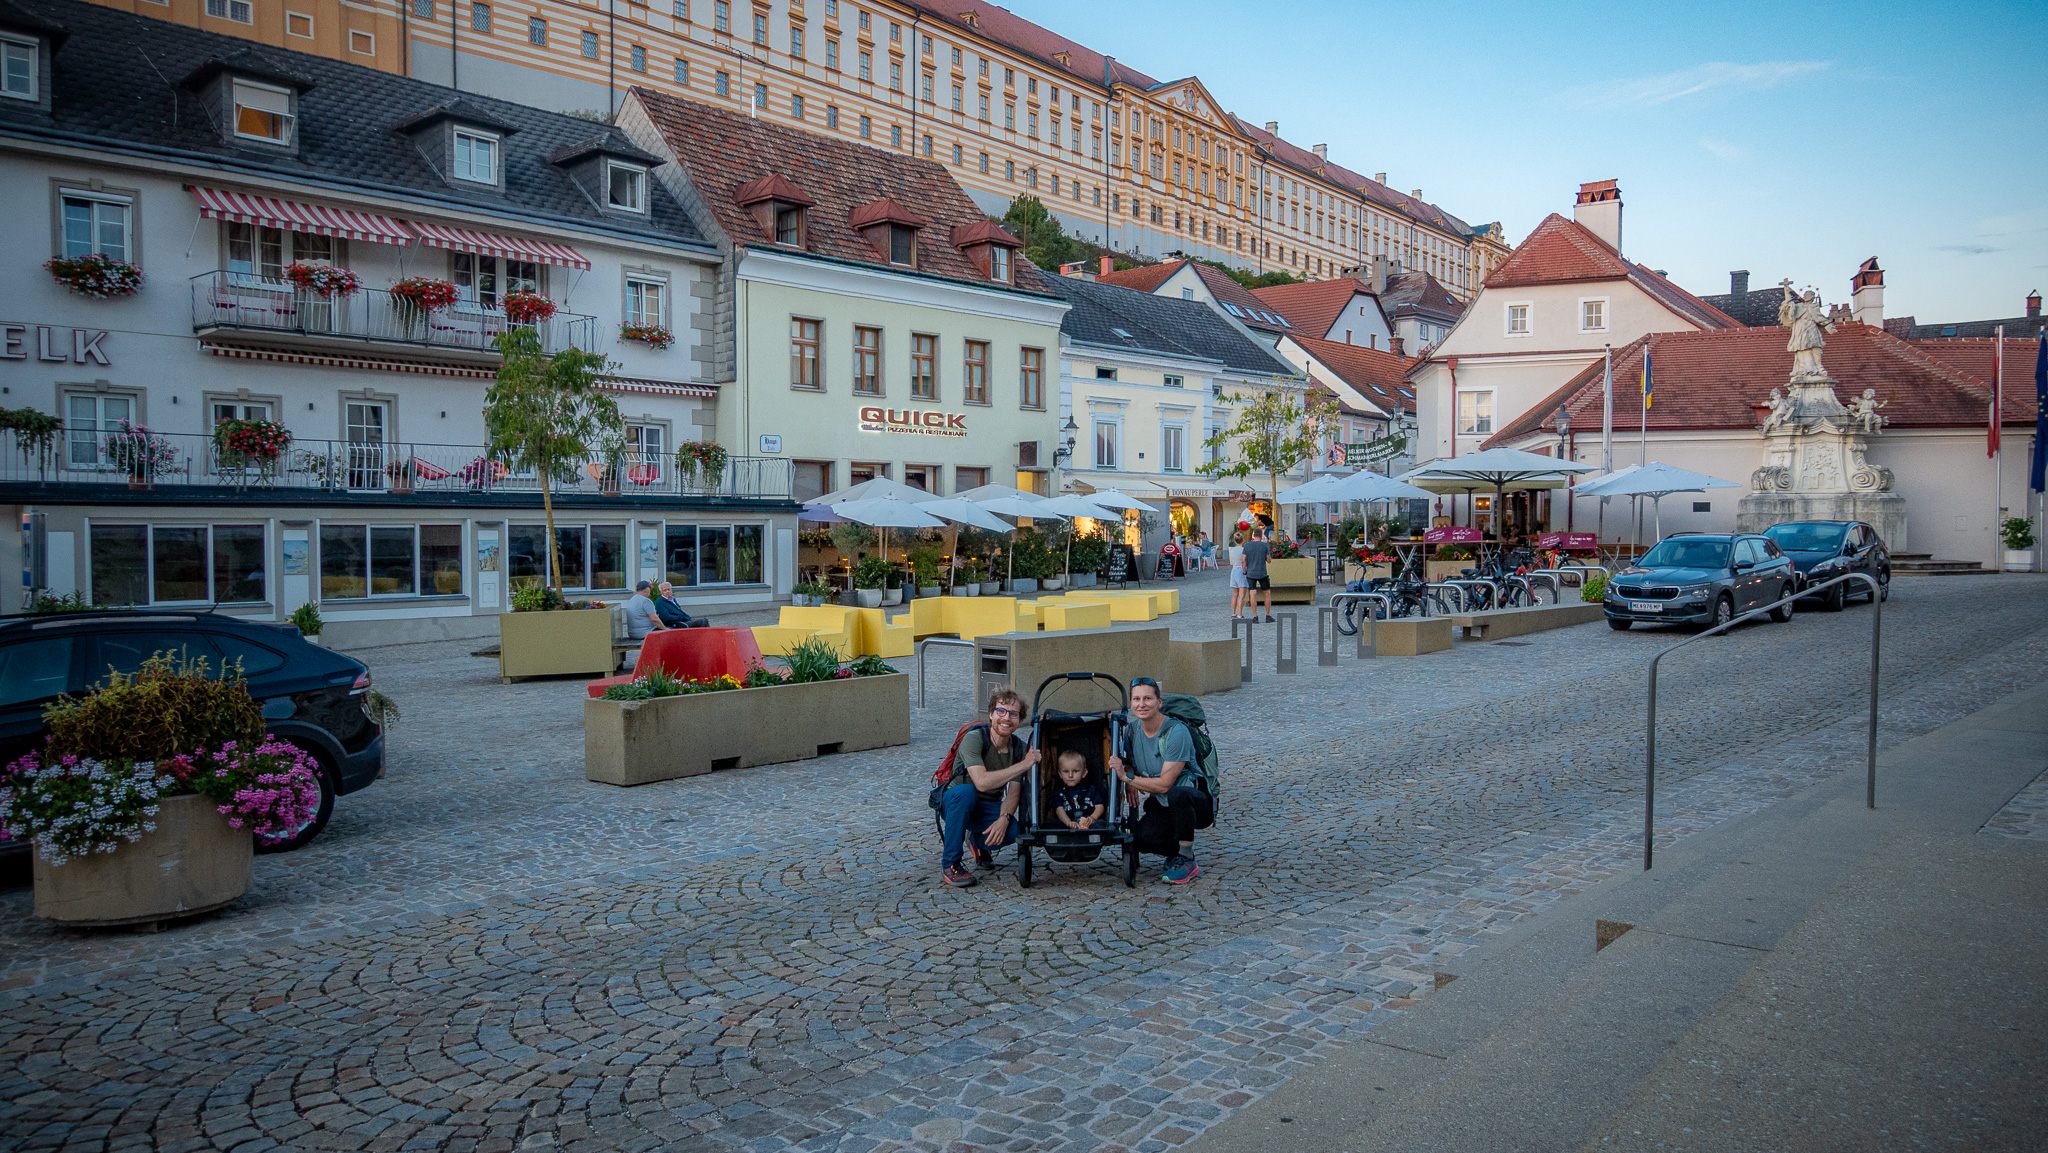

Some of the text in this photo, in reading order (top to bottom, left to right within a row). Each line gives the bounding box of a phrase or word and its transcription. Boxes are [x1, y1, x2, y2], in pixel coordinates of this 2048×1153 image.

[0, 323, 112, 366] ELK
[861, 407, 968, 429] QUICK
[925, 429, 968, 437] RESTAURANT
